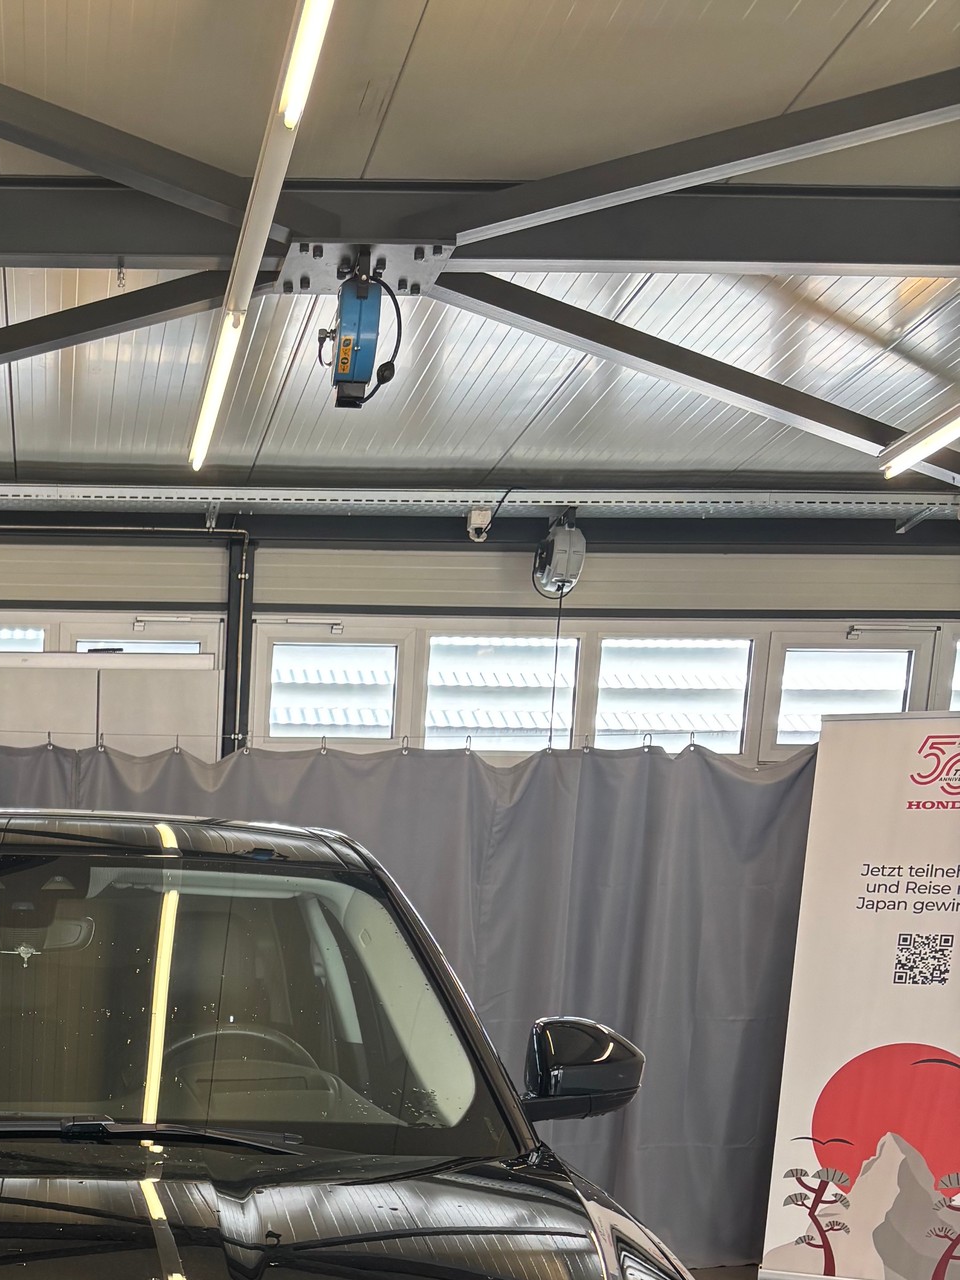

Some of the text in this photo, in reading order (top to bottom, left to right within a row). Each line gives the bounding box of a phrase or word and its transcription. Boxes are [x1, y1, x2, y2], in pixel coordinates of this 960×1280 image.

[860, 863, 904, 877] Jetzt
[866, 880, 900, 893] und
[905, 881, 951, 894] Reise
[856, 896, 907, 912] Japan
